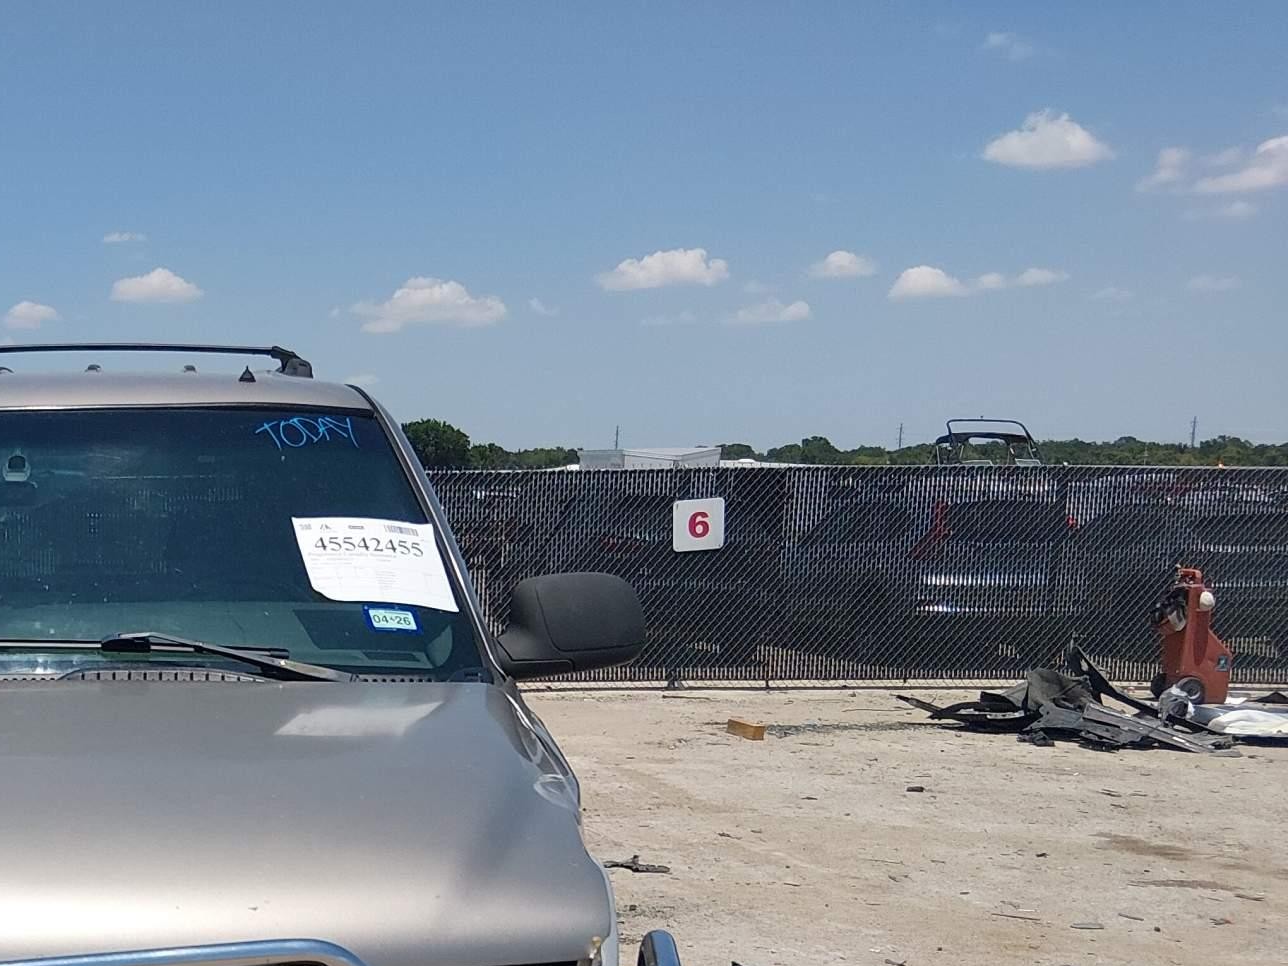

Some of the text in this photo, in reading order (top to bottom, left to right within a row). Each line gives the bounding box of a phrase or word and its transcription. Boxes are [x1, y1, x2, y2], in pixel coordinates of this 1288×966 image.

[255, 417, 360, 451] TODAY
[688, 511, 710, 538] 6
[314, 536, 424, 557] 45542455
